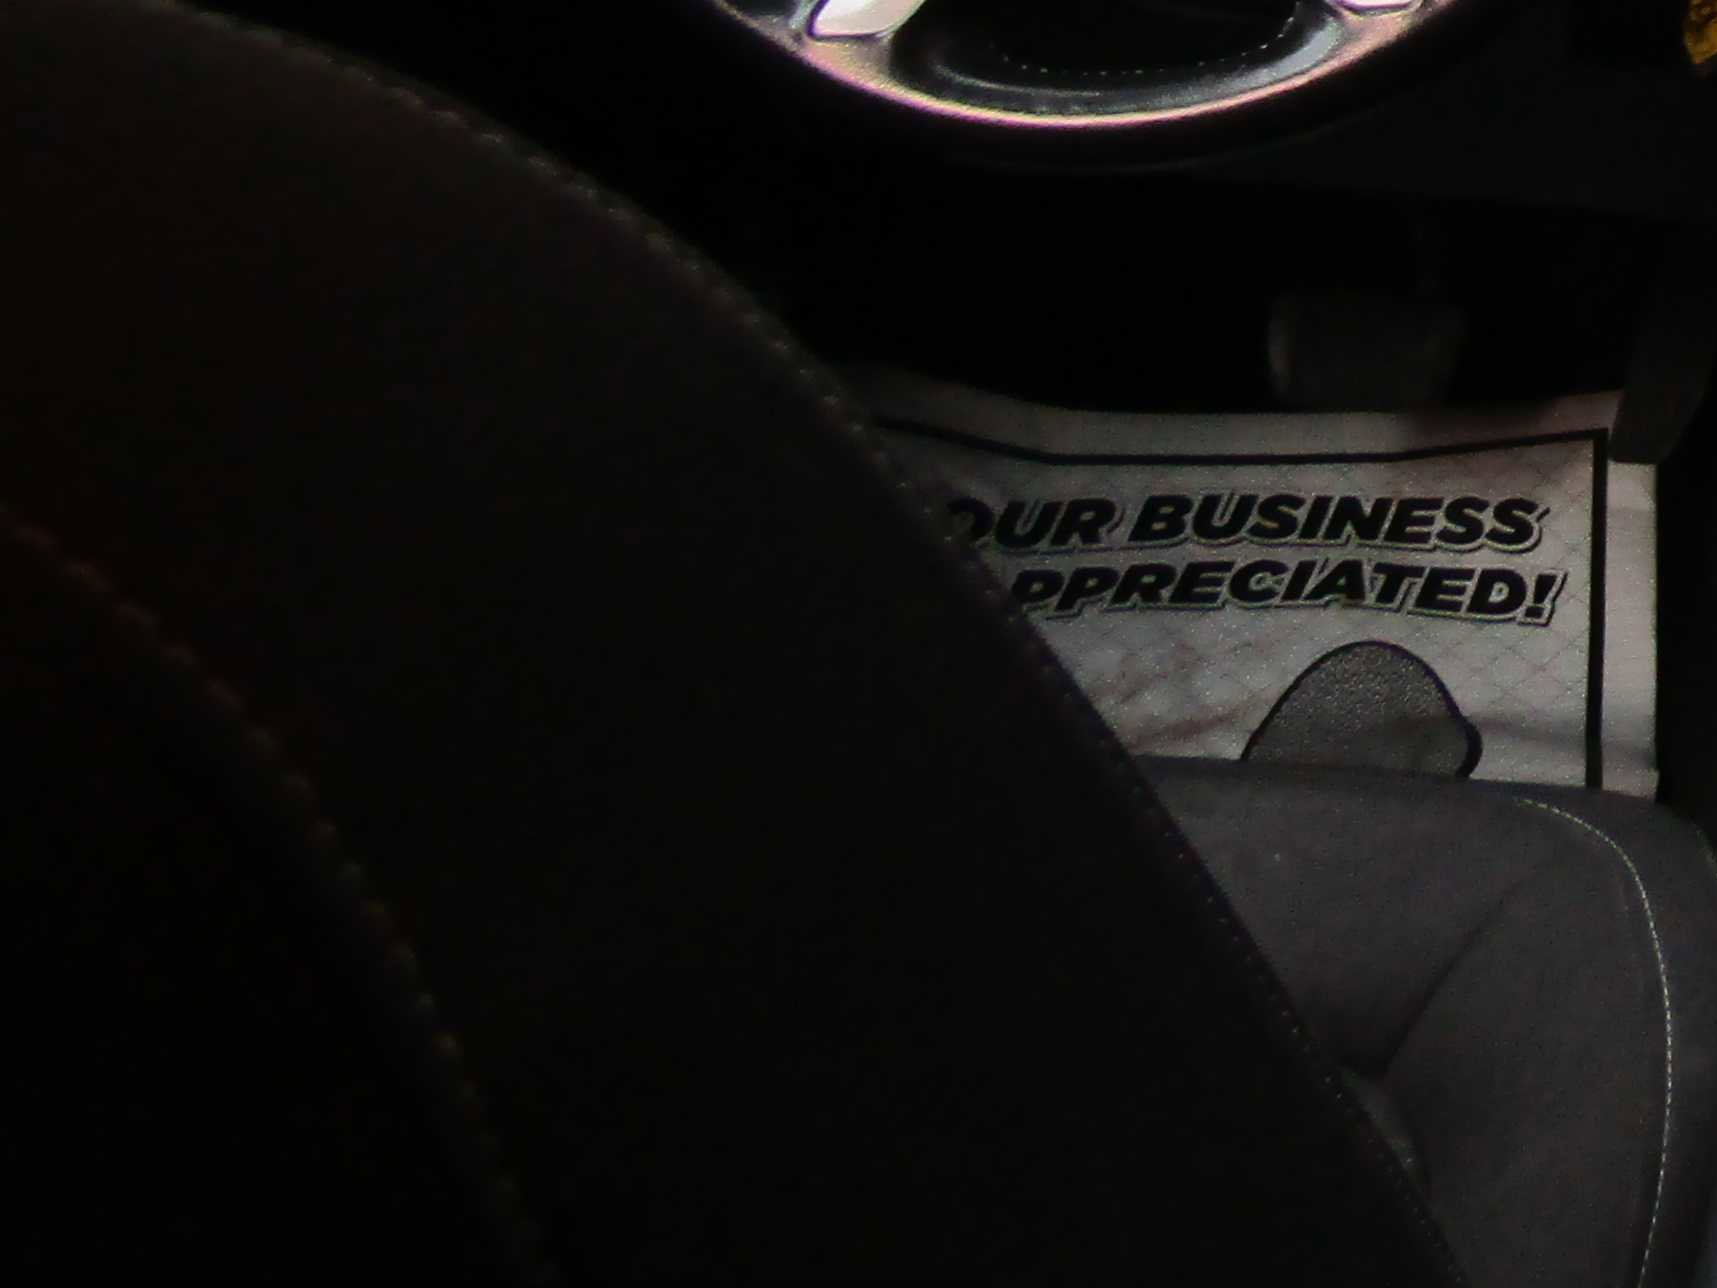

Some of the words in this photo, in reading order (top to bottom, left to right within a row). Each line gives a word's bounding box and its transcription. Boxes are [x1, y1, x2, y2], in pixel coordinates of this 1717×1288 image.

[946, 497, 1122, 548] OUR
[1127, 494, 1547, 551] BUSINESS
[1010, 560, 1562, 620] PPRECIATED!
